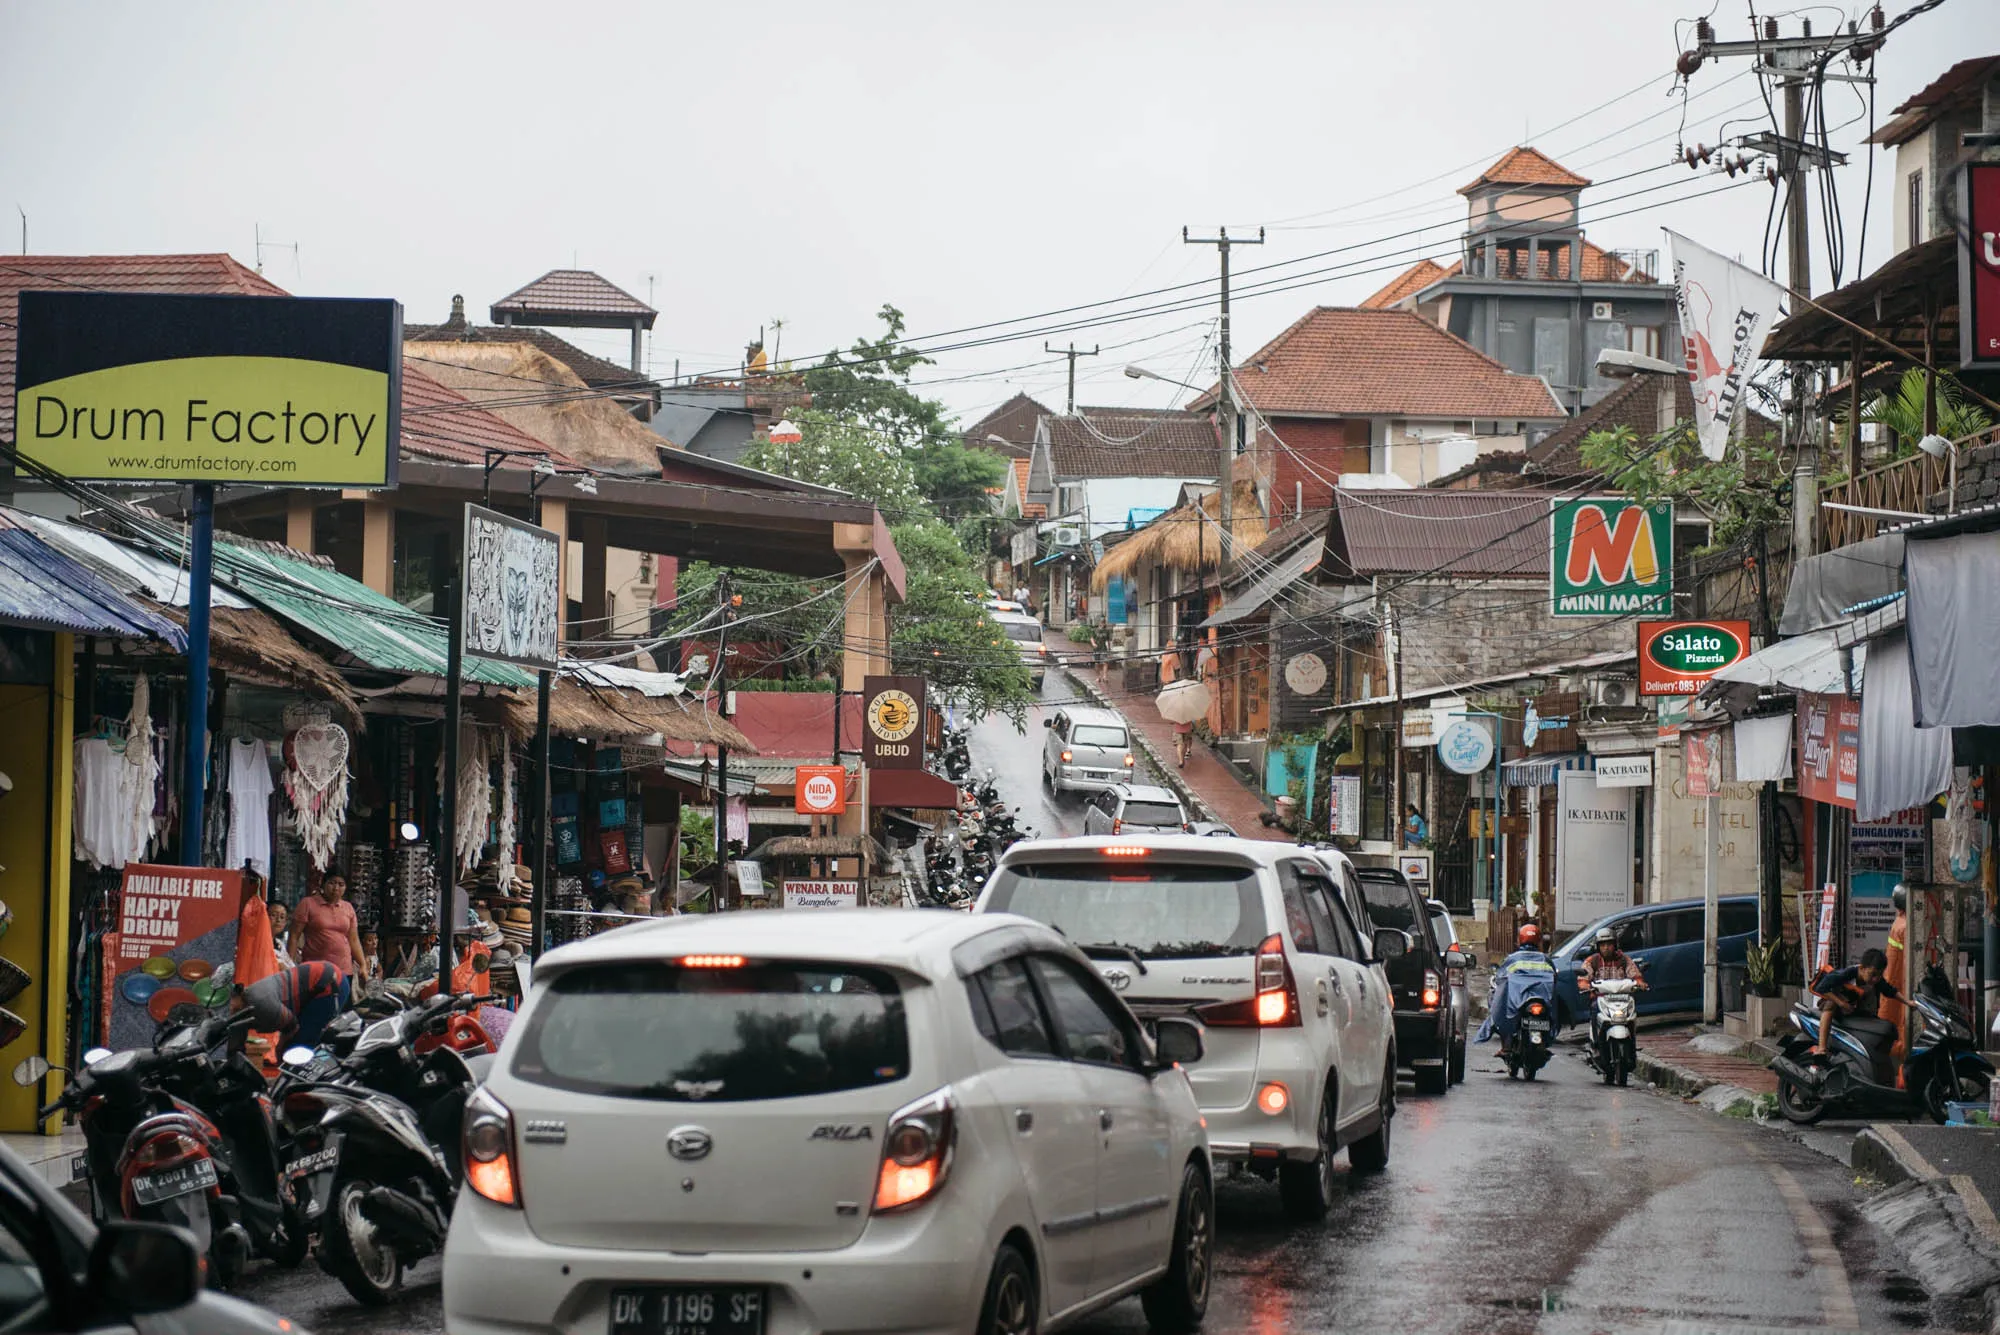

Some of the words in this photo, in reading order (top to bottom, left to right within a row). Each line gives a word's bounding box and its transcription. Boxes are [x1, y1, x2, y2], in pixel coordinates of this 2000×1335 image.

[34, 396, 165, 442] Drum
[186, 399, 376, 457] Factory
[107, 455, 297, 474] www.drumfactory.com
[1559, 594, 1607, 611] MINI
[1609, 594, 1666, 611] MART
[1662, 634, 1721, 651] Salato
[1685, 653, 1725, 664] Pizzeria
[1645, 681, 1678, 693] Delivery:
[1678, 680, 1695, 691] 085
[870, 692, 892, 714] KOPI
[897, 692, 917, 714] BALI
[875, 726, 910, 740] HOUSE
[875, 743, 910, 757] UBUD
[1598, 765, 1649, 776] IKATBATIK
[808, 783, 832, 794] NIDA
[1568, 809, 1627, 821] IKATBATIK
[1692, 807, 1751, 830] HTEL
[1851, 827, 1909, 838] BUNGALOWS
[126, 875, 191, 897] AVAILABLE
[192, 879, 223, 899] HERE
[785, 883, 829, 895] WENARA
[832, 884, 857, 895] BALI
[124, 896, 181, 919] HAPPY
[798, 896, 842, 907] Bungalow
[122, 917, 179, 937] DRUM
[135, 1174, 152, 1191] DK
[614, 1295, 645, 1324] DK
[661, 1293, 714, 1323] 1196
[729, 1293, 759, 1323] SF
